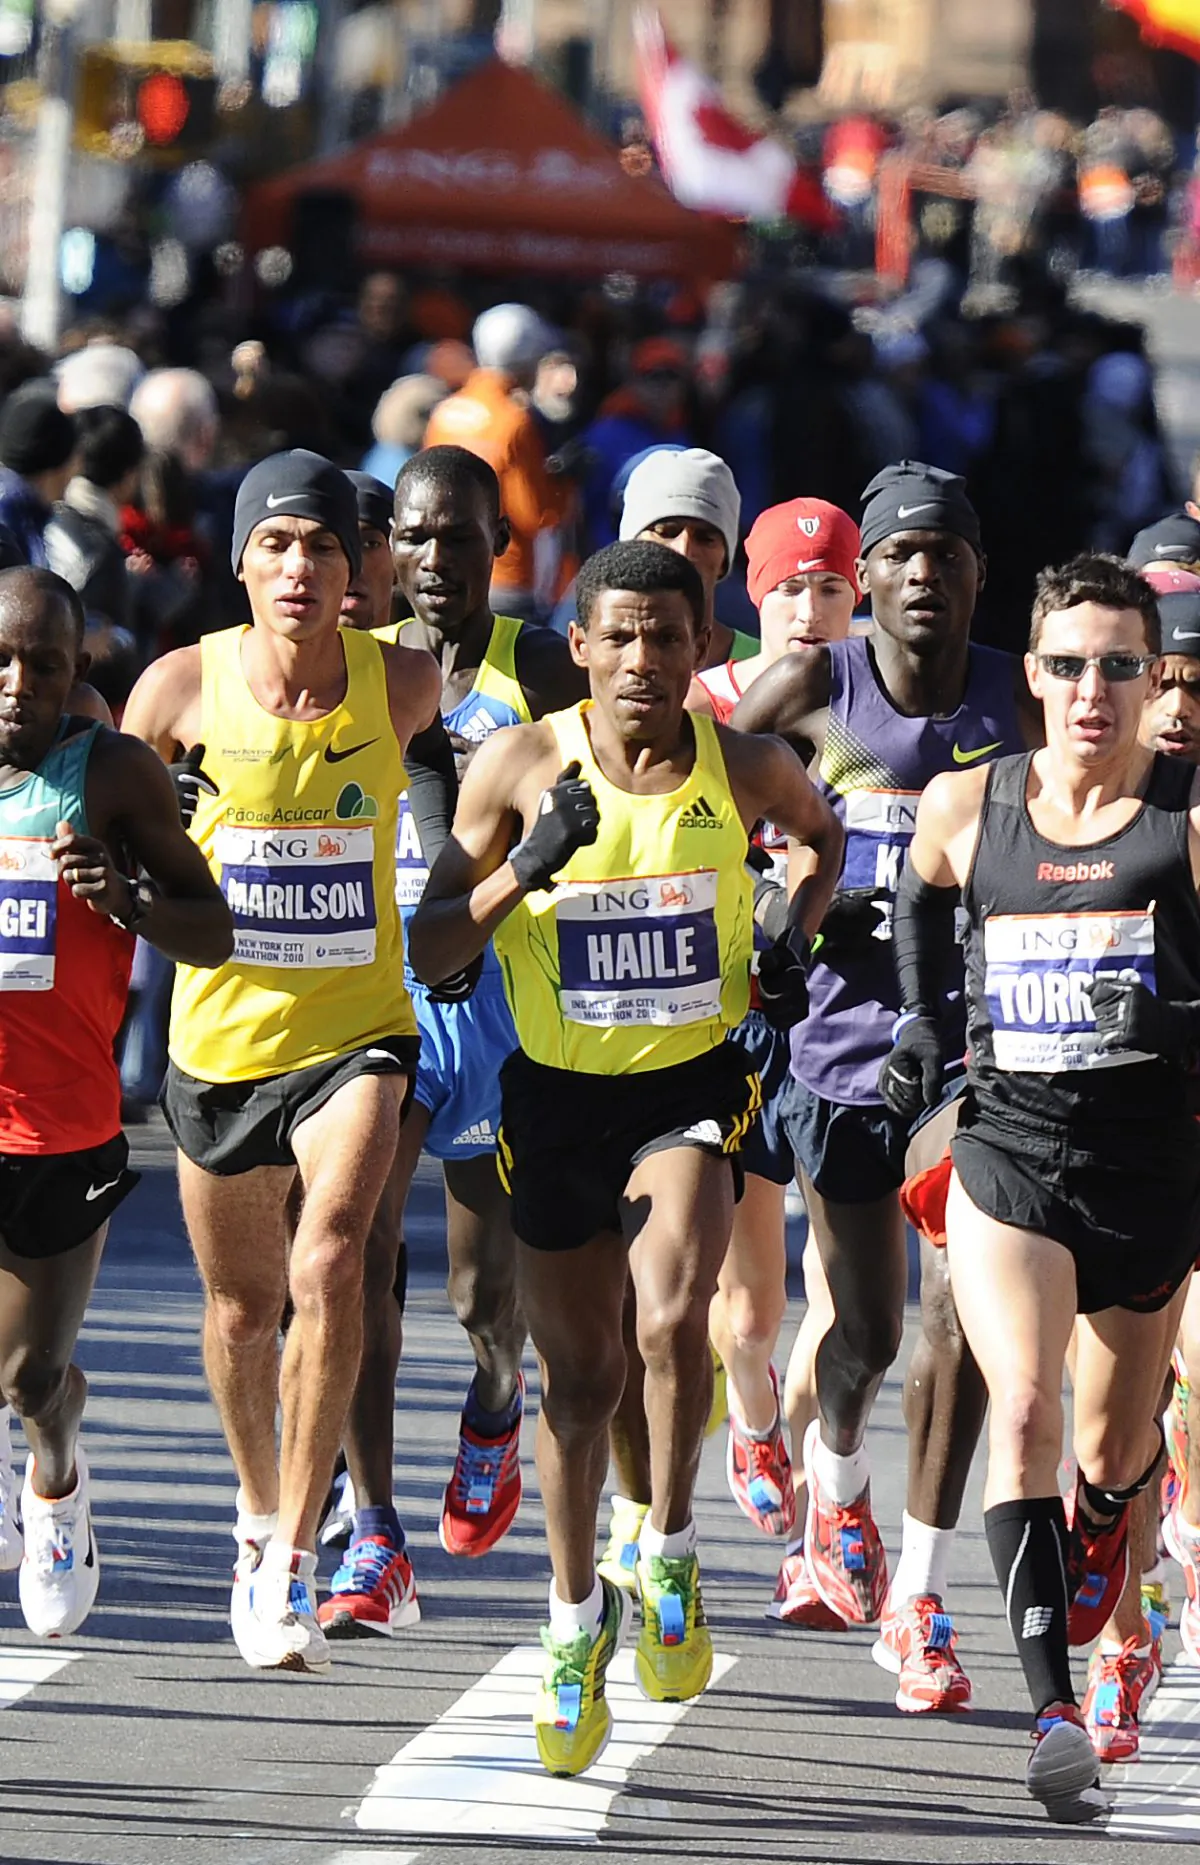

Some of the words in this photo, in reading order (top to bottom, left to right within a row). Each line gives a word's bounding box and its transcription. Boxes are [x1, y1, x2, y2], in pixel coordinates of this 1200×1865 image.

[678, 814, 723, 829] adidas
[251, 839, 308, 858] ING
[875, 844, 901, 892] K
[1037, 860, 1115, 881] Reebok
[227, 877, 366, 920] MARILSON
[591, 889, 650, 912] ING
[0, 898, 48, 938] GEI
[238, 938, 256, 949] NEW
[259, 940, 282, 951] YORK
[284, 943, 305, 952] CITY
[1022, 929, 1078, 950] ING
[234, 949, 279, 962] MARATHON
[283, 953, 304, 962] 2010
[586, 926, 697, 981] HAILE
[571, 999, 587, 1009] ING
[636, 998, 657, 1008] CITY
[994, 969, 1142, 1025] TORR
[452, 1134, 496, 1145] adidas
